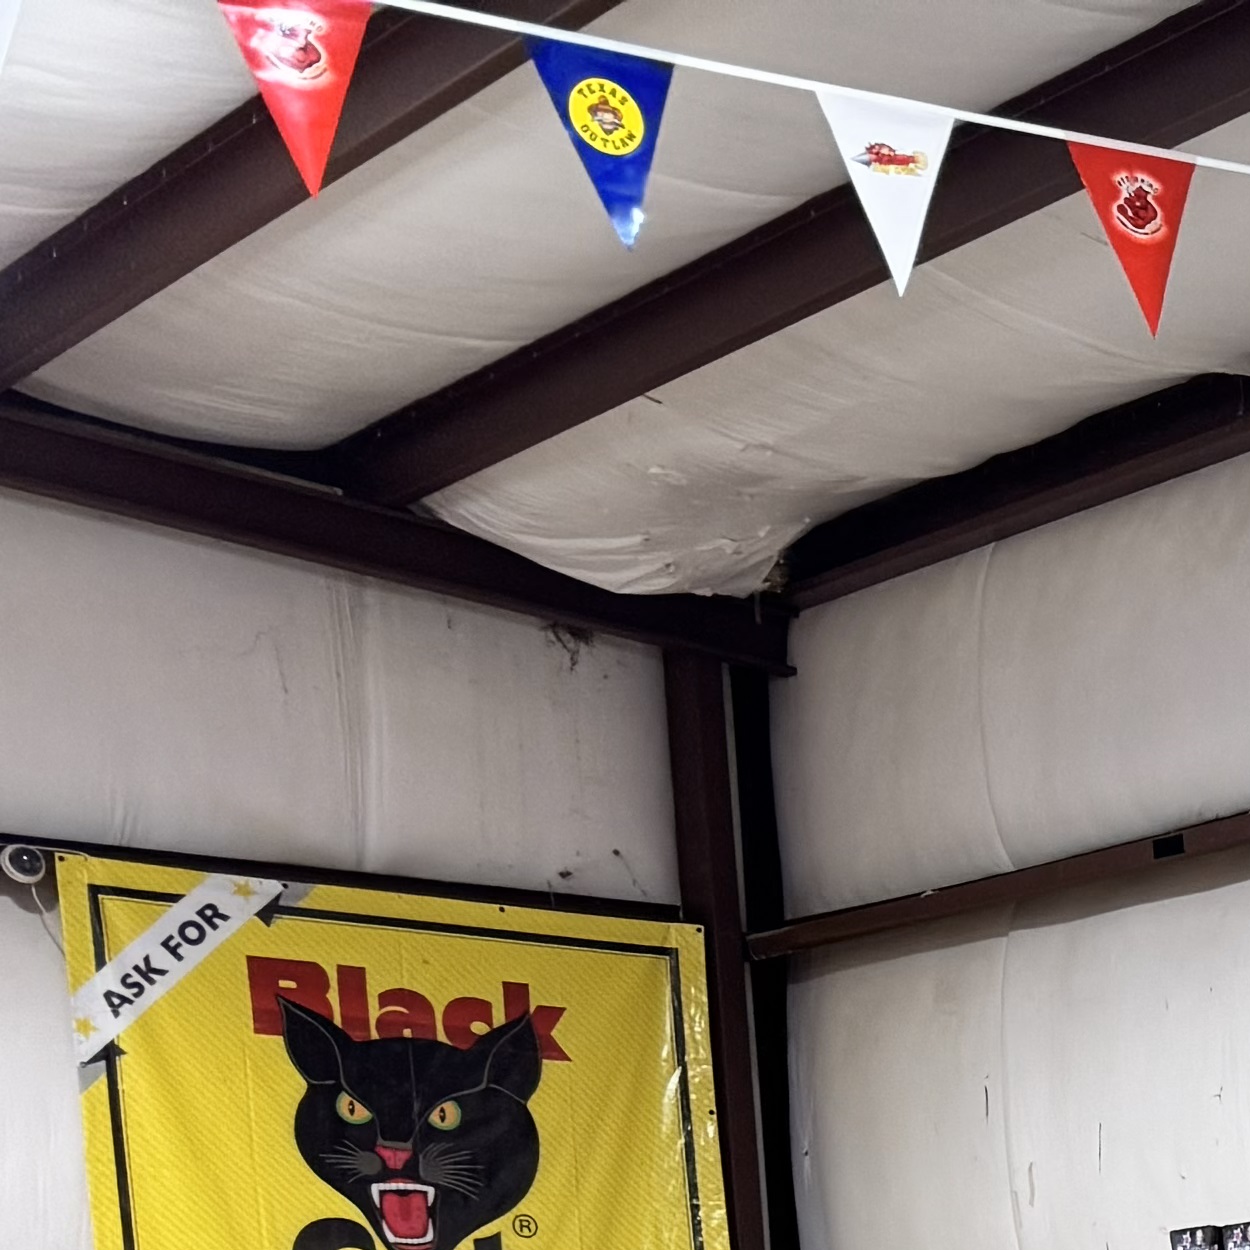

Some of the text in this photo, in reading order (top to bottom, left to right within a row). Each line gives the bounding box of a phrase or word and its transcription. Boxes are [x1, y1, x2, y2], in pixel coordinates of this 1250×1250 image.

[577, 83, 629, 106] TEXAS
[580, 123, 637, 150] OUTLAW
[101, 901, 231, 1019] ASK FOR
[245, 955, 573, 1062] Black
